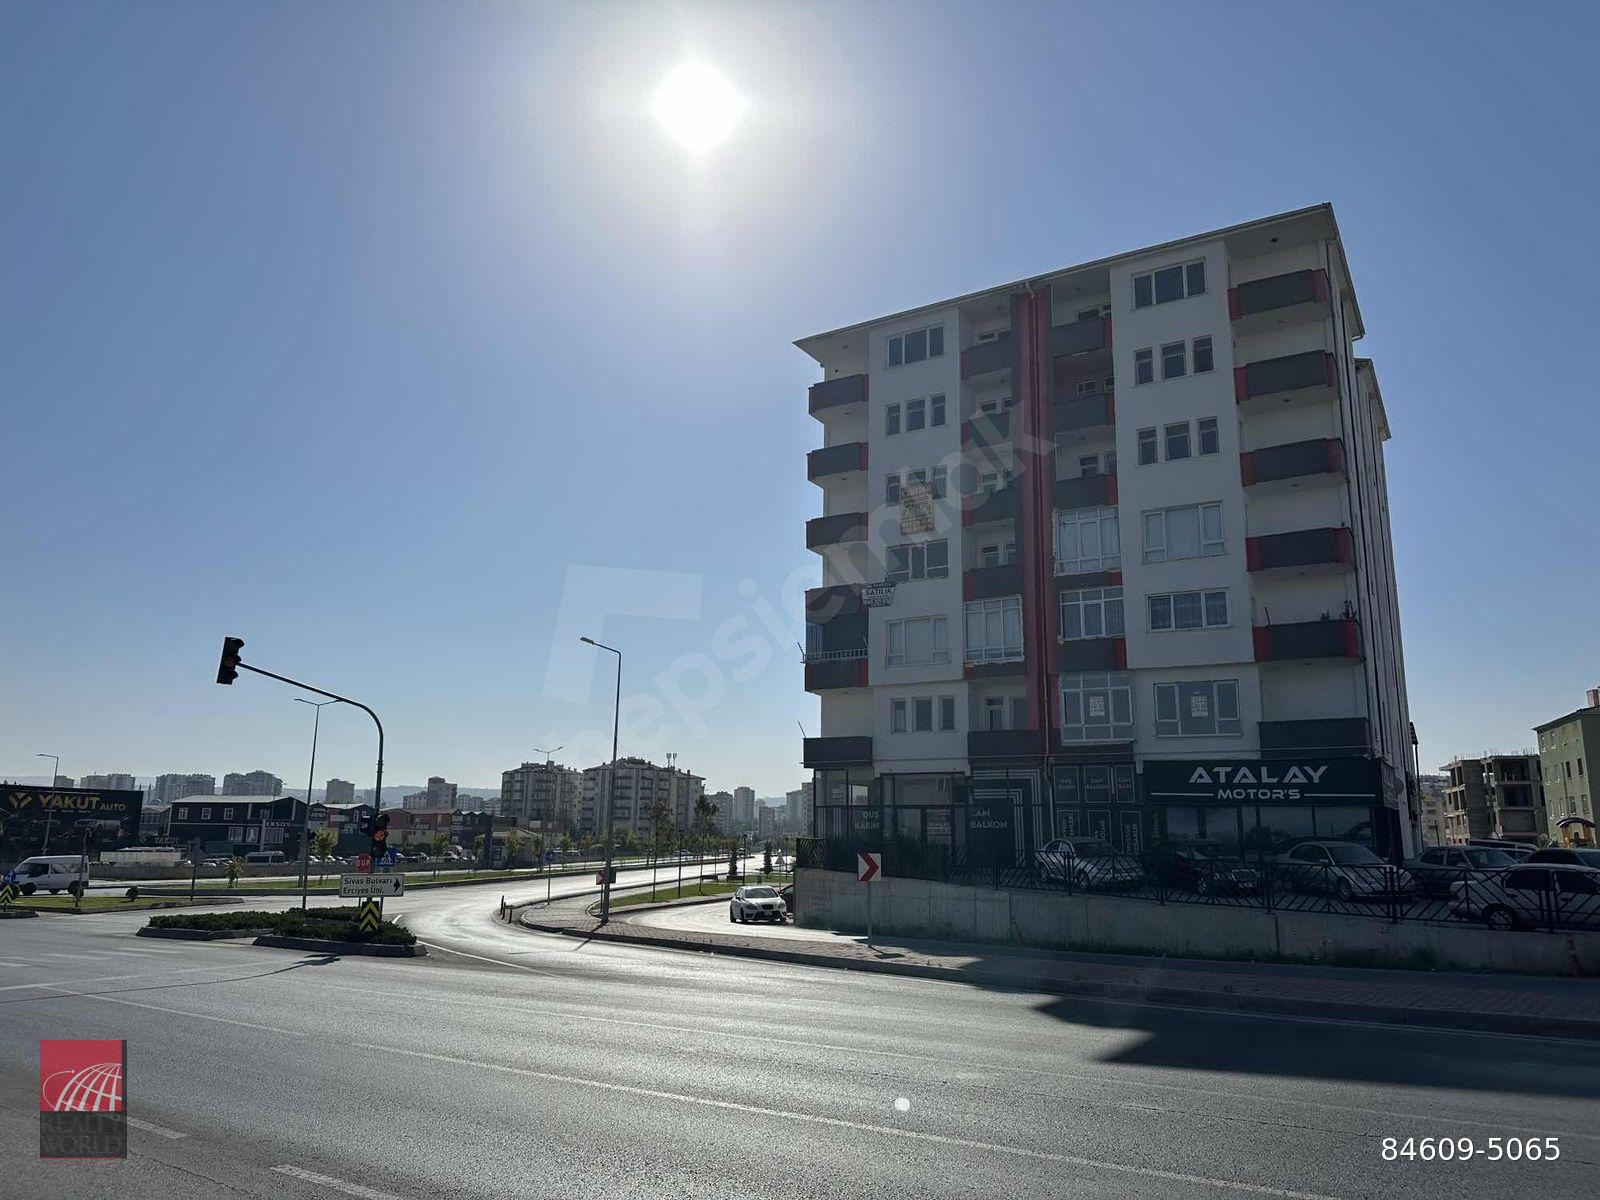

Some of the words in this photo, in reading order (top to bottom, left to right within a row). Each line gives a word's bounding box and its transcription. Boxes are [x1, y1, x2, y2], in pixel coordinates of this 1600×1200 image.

[1188, 765, 1329, 784] ATALAY
[1217, 788, 1302, 800] MOTOR'S
[38, 793, 101, 810] YAKUT
[98, 802, 128, 812] AUTO
[970, 820, 1008, 829] BALKON
[344, 877, 364, 885] Sivas
